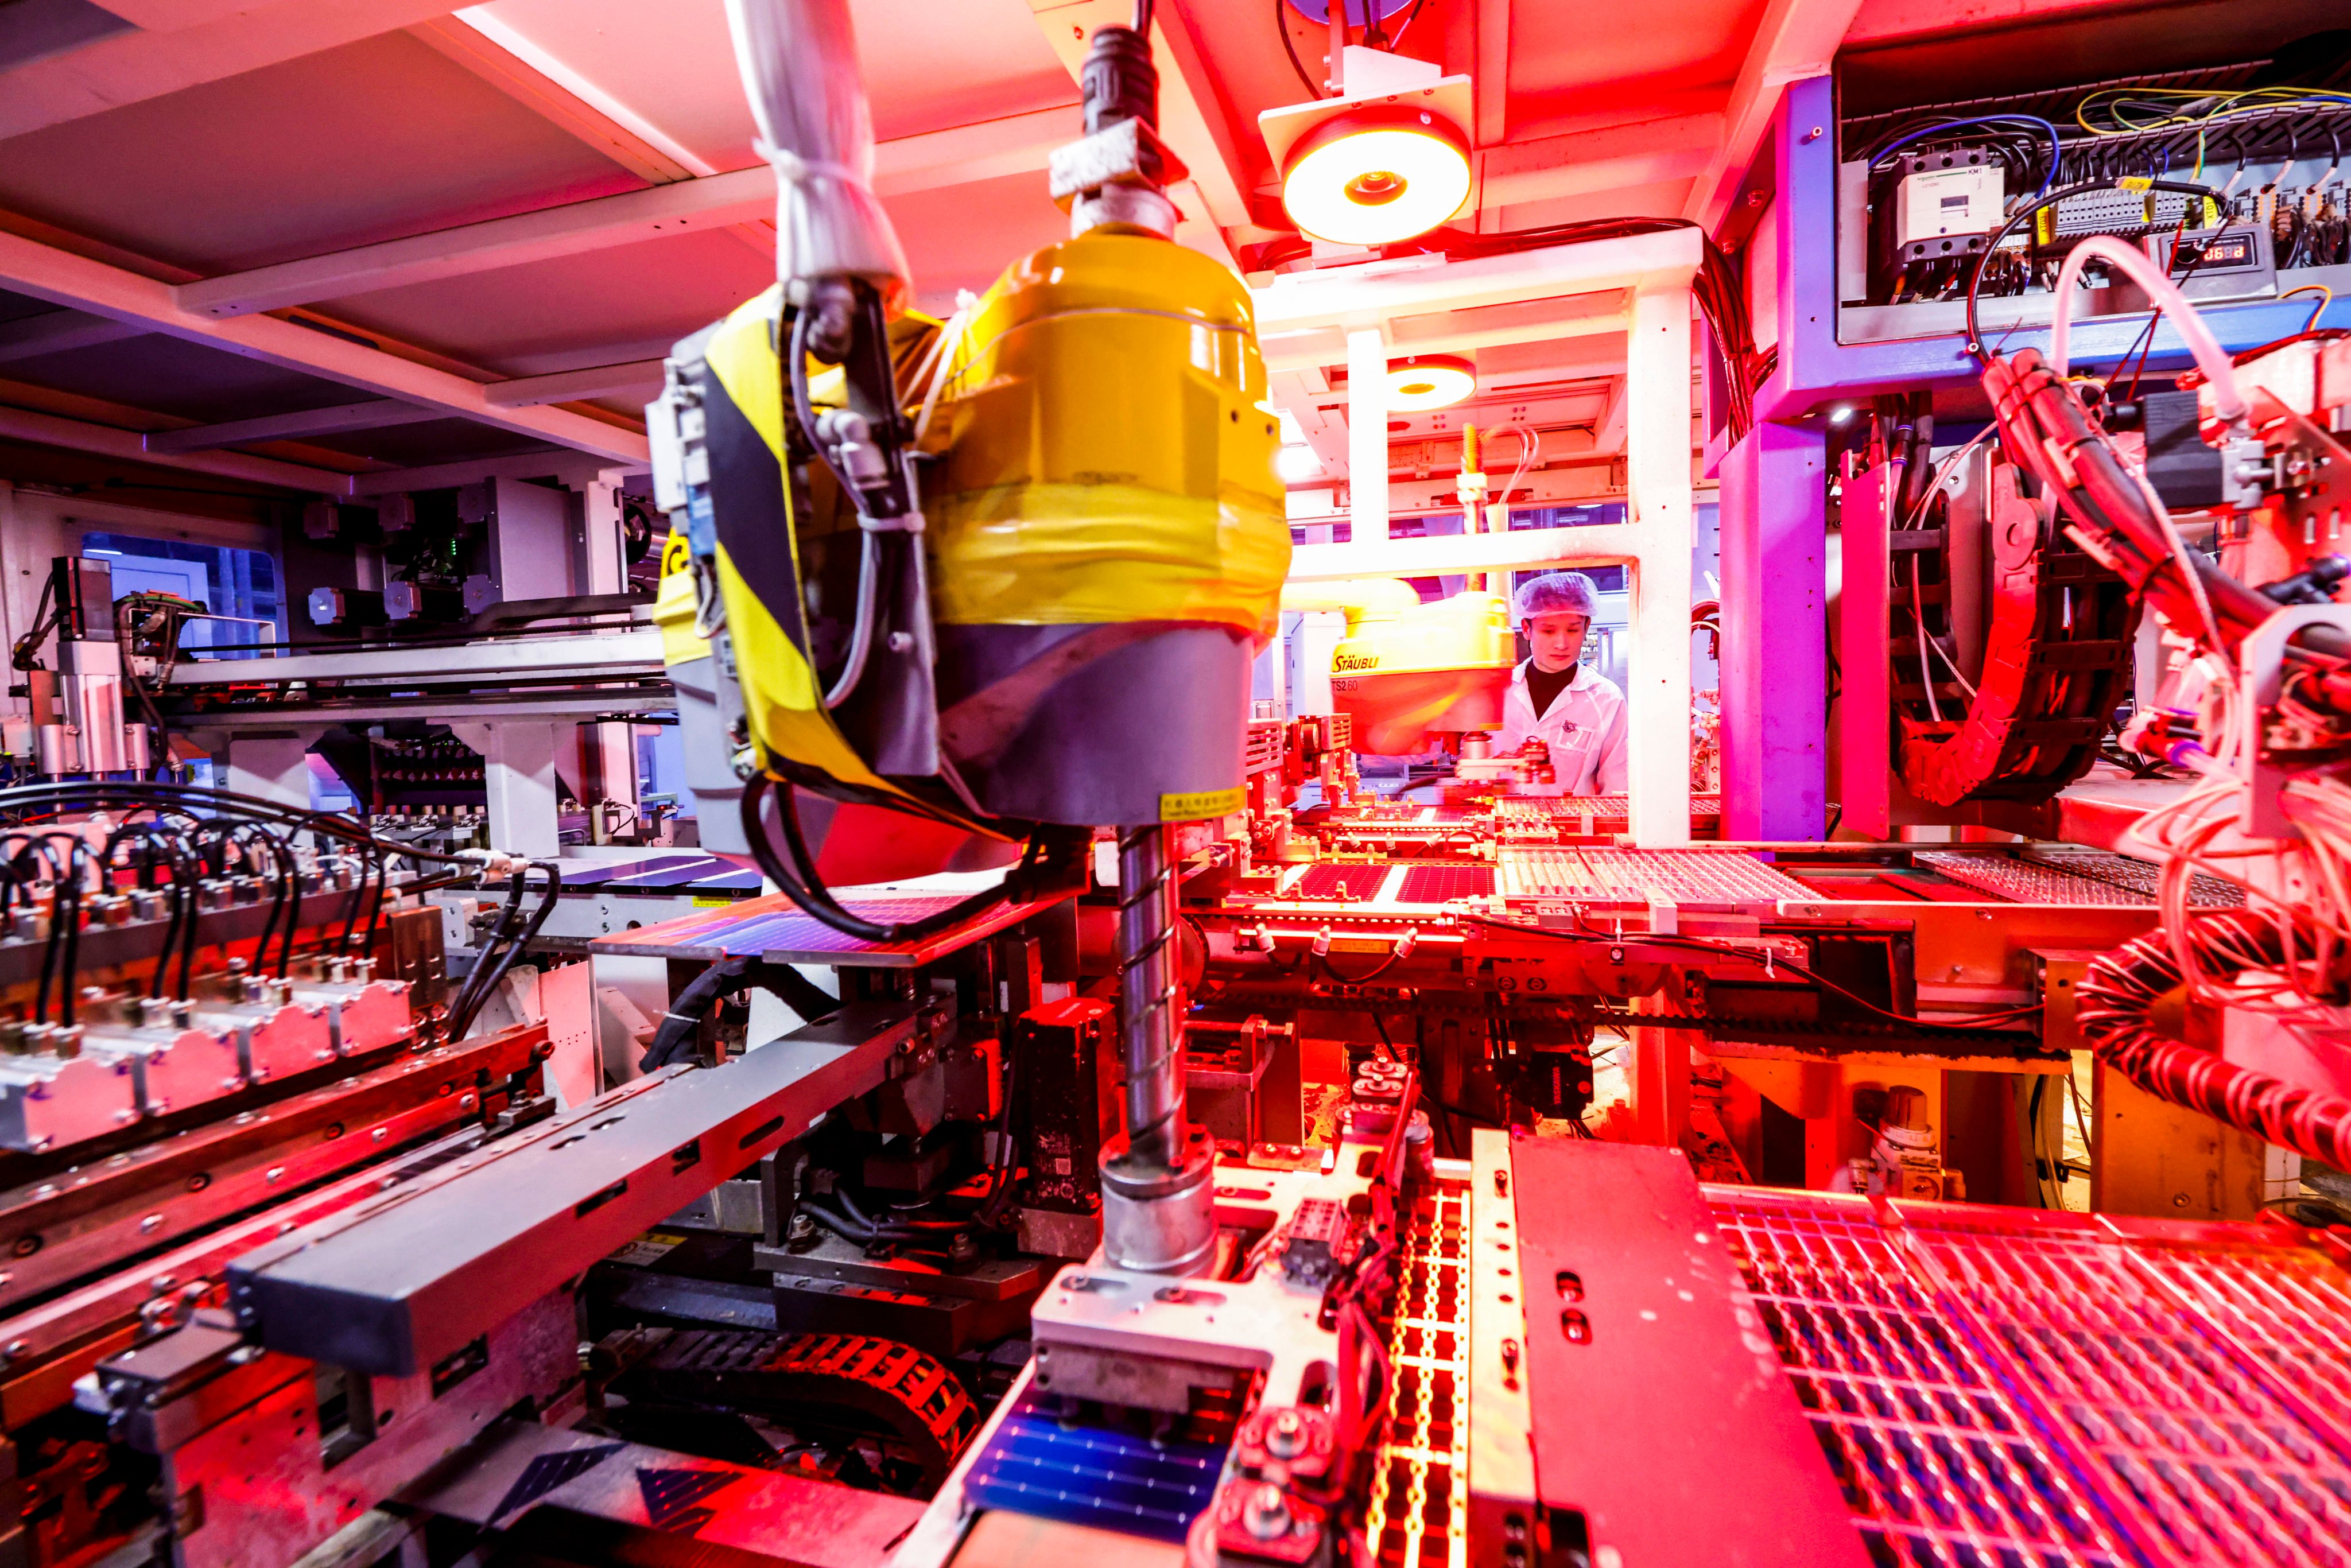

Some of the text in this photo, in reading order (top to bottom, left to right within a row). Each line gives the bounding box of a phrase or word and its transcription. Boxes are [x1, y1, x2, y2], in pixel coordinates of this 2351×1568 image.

[2206, 201, 2214, 219] XT01
[2039, 216, 2047, 233] XT03
[1332, 655, 1379, 673] STÄUBLI
[1348, 680, 1358, 692] 60
